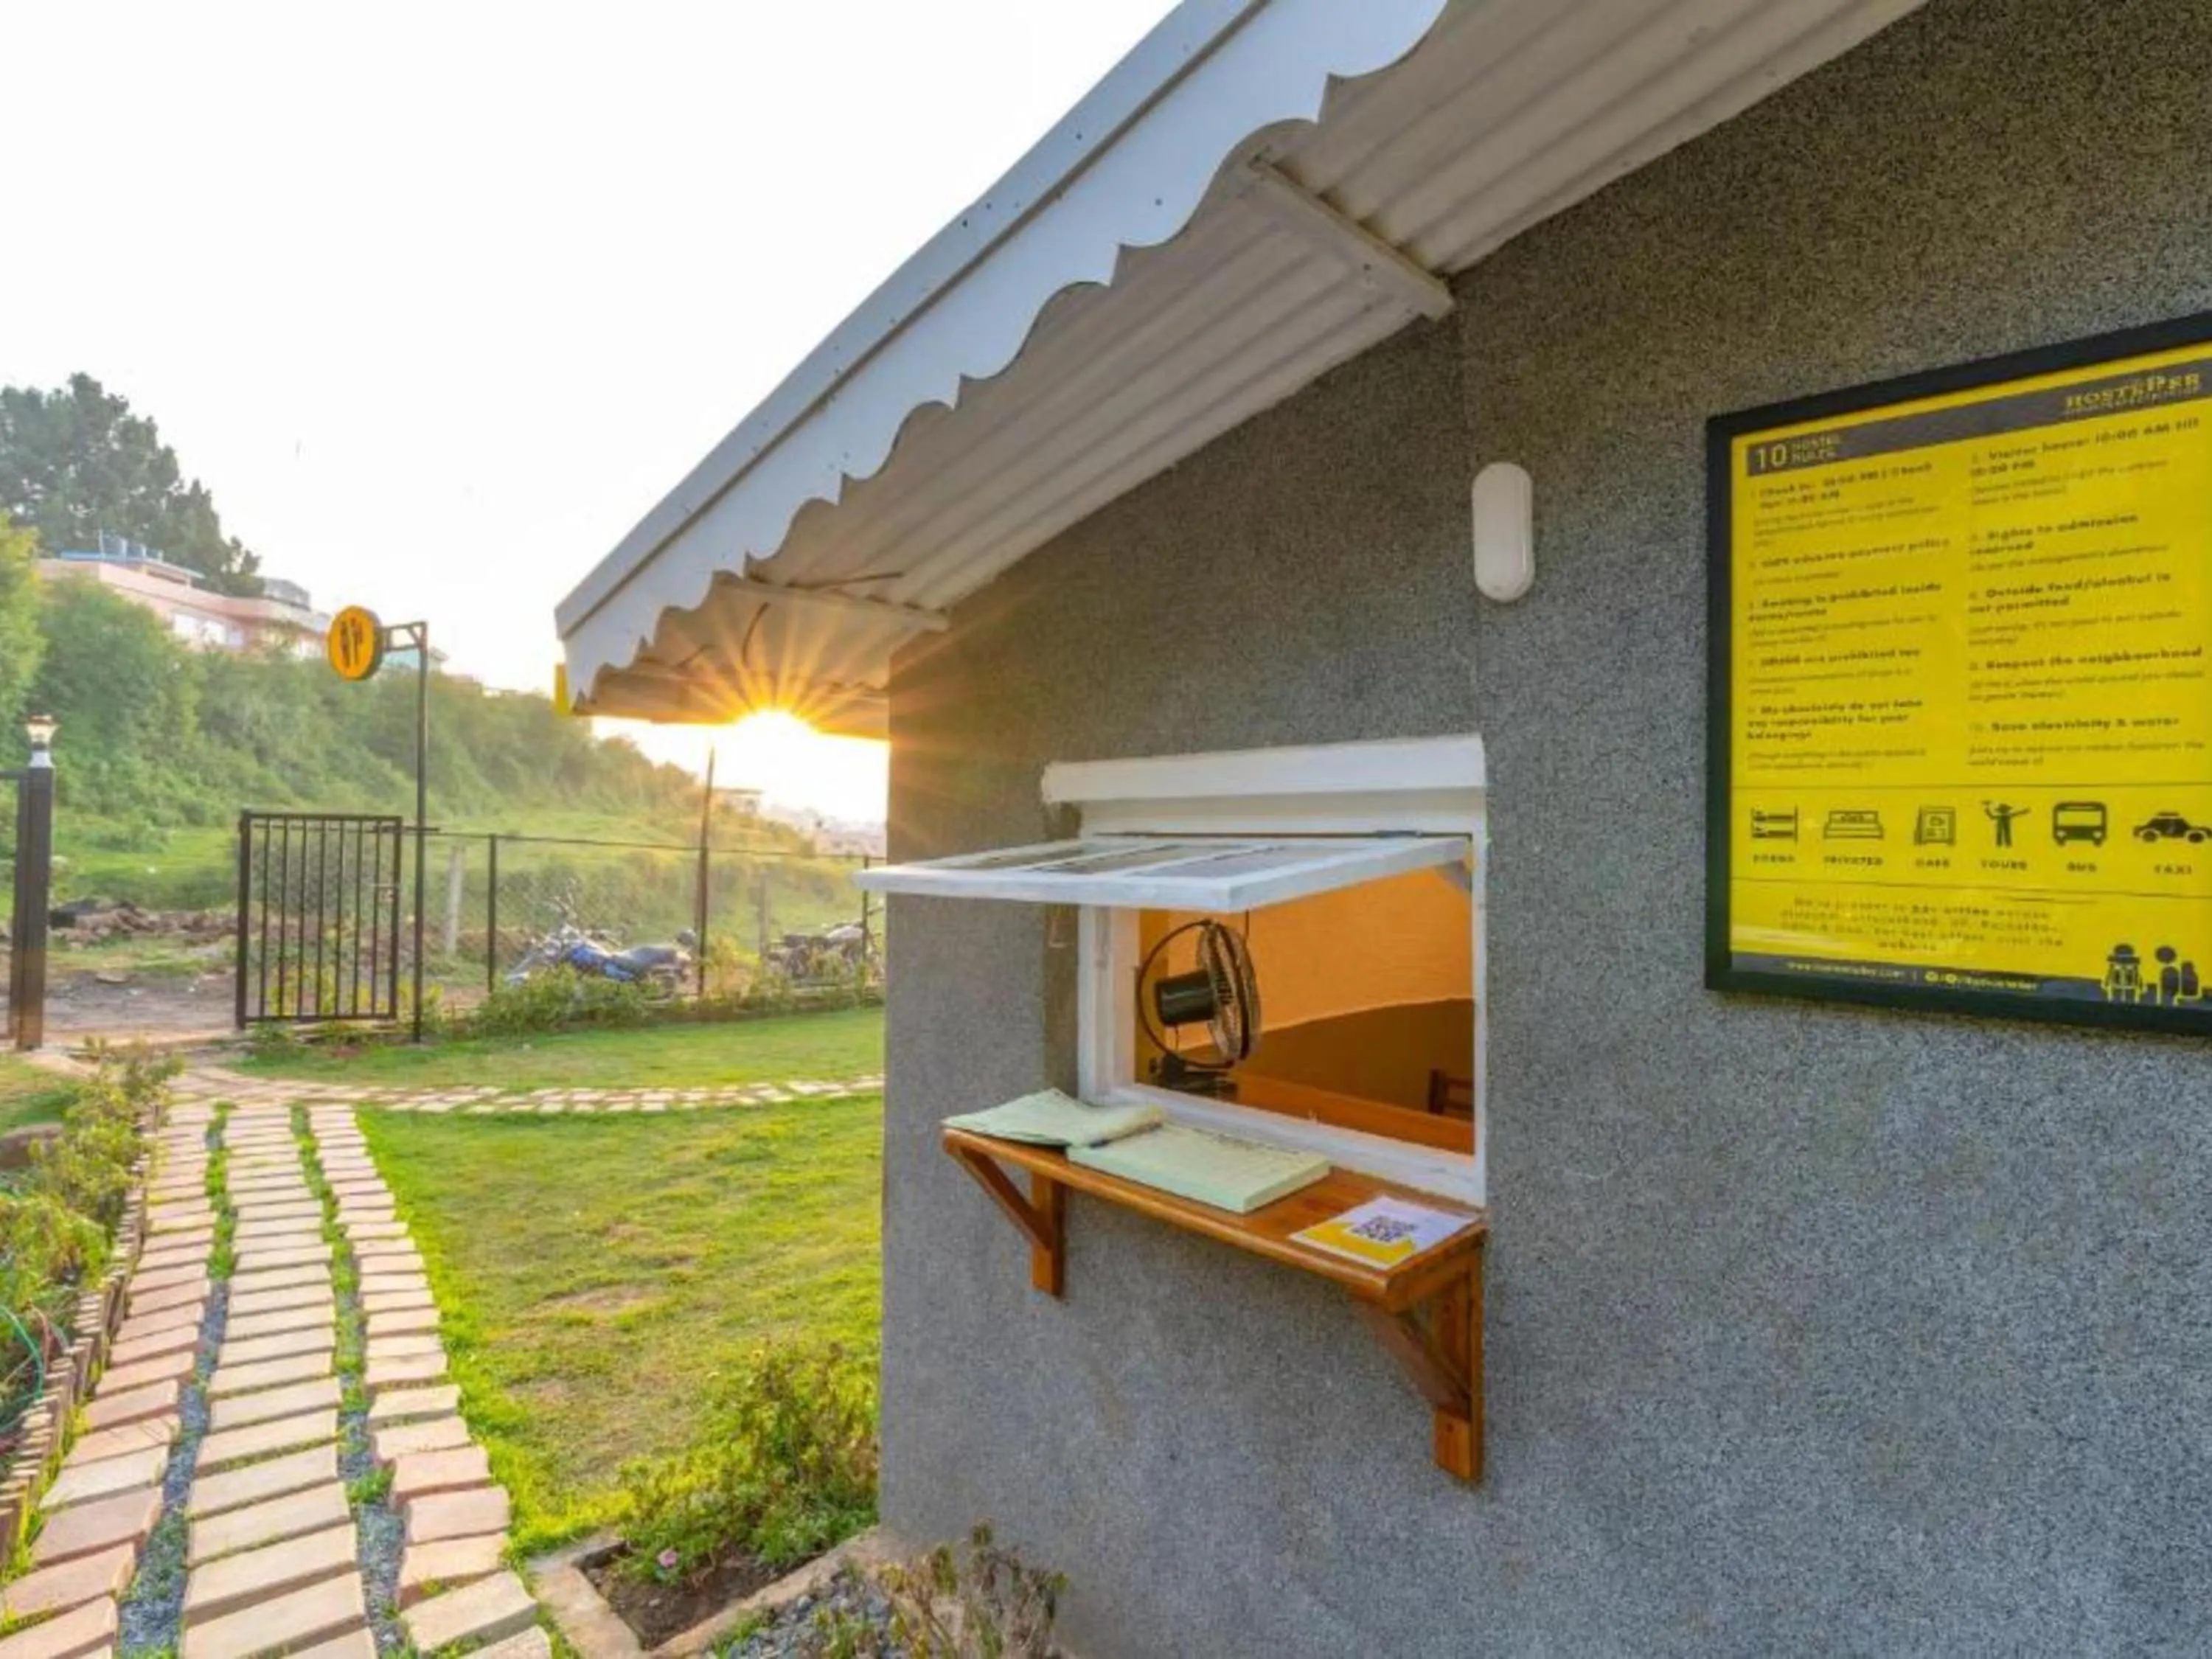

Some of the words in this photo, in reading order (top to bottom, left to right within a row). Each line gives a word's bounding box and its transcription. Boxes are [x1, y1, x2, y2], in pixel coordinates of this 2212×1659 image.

[1756, 444, 1787, 470] 10
[1980, 859, 2028, 872] TOURS
[2066, 862, 2098, 874] BUS
[2154, 863, 2193, 875] TAXI
